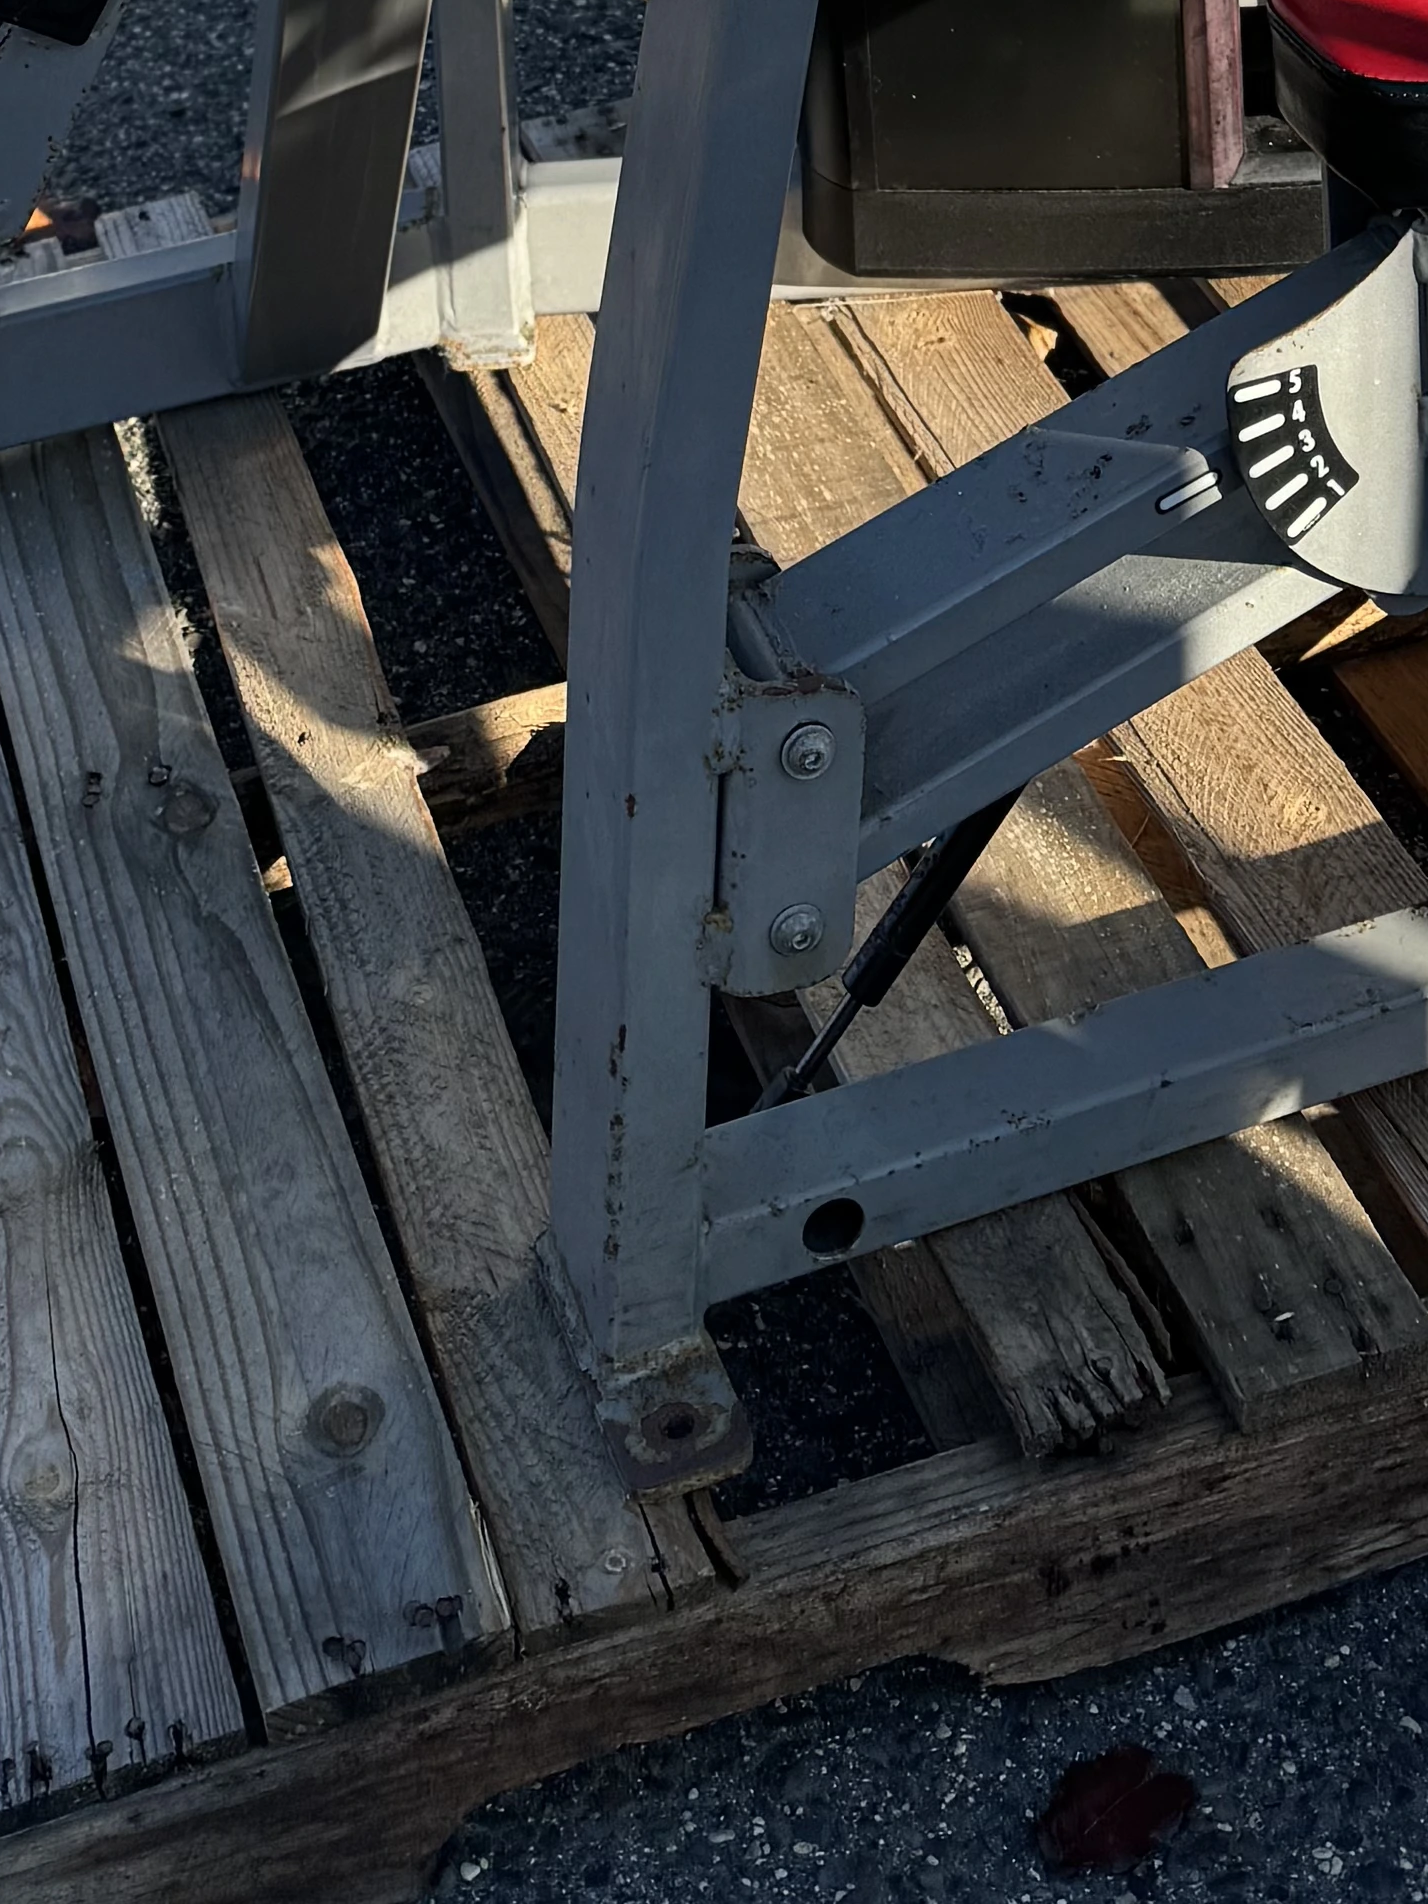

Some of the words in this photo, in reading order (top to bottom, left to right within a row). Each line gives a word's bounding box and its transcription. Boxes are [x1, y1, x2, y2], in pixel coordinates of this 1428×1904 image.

[1289, 369, 1301, 393] 5
[1292, 400, 1306, 422] 4
[1298, 429, 1316, 452] 3
[1310, 455, 1329, 478] 2
[1326, 479, 1345, 496] 1
